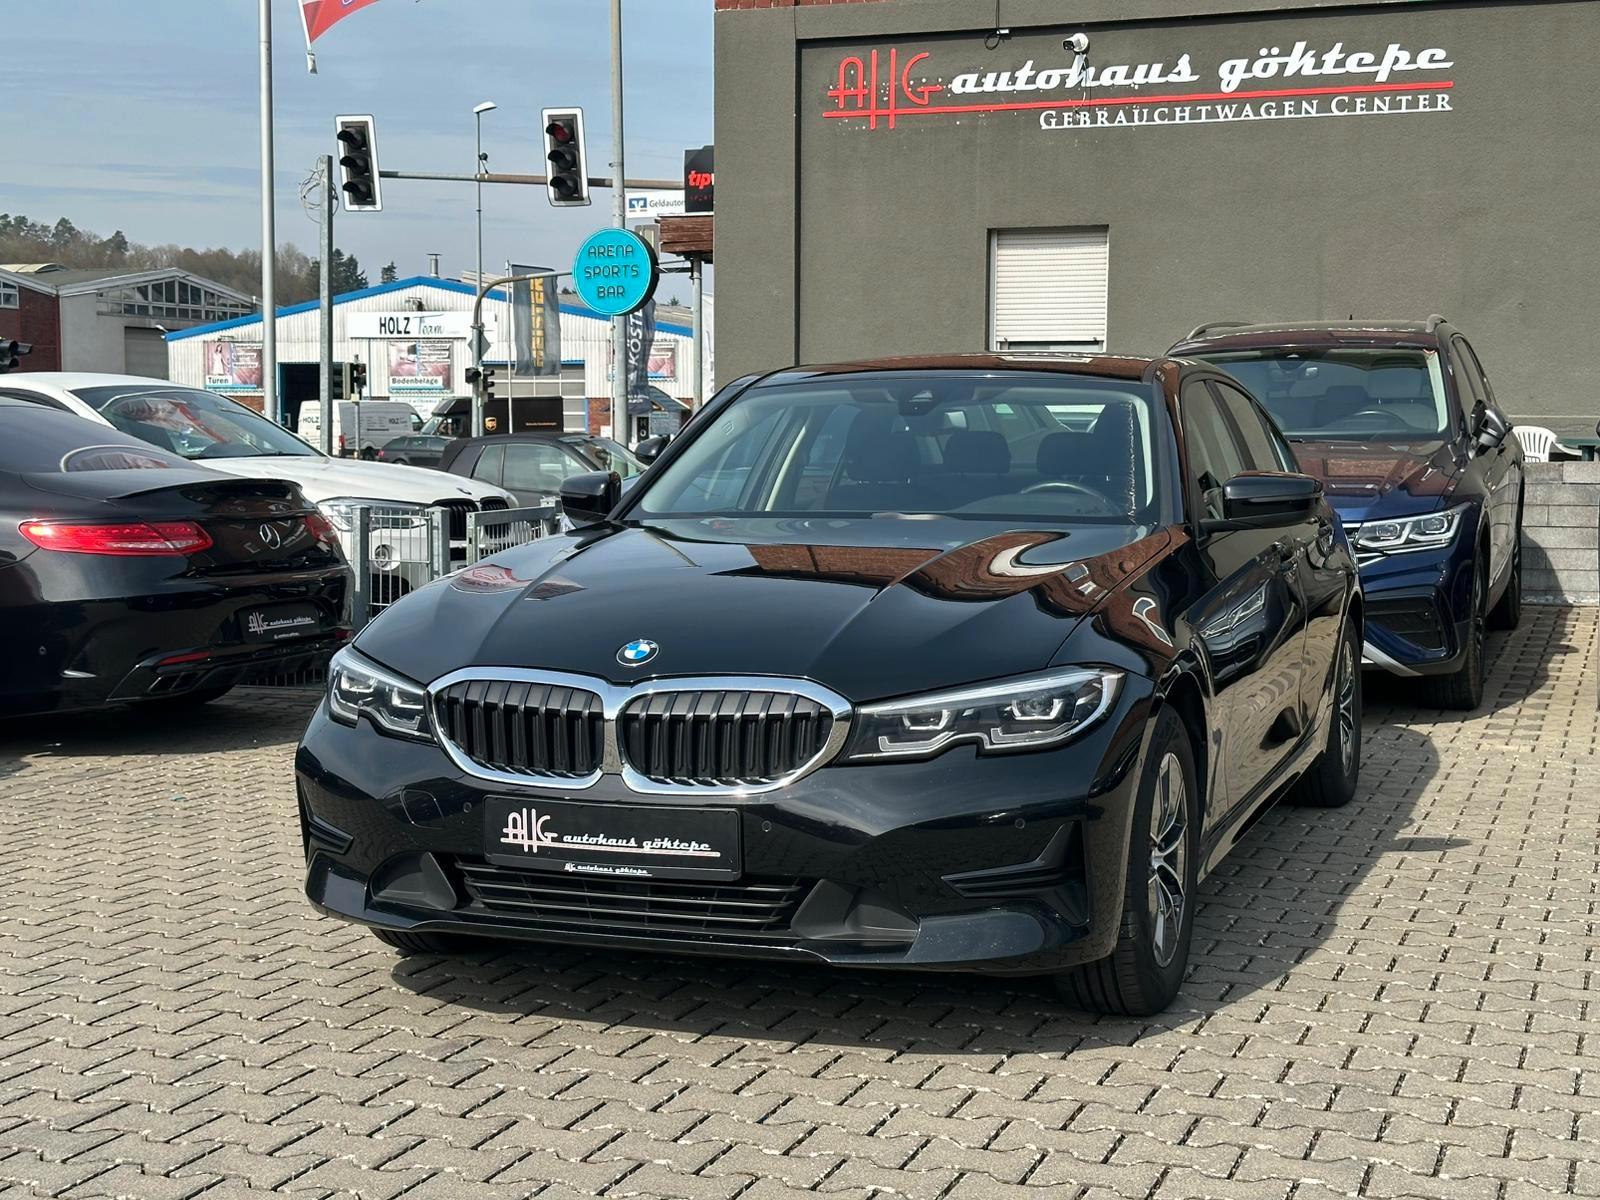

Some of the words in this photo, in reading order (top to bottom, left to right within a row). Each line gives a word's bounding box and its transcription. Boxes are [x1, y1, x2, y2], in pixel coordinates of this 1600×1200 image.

[951, 52, 1200, 95] autohaus
[1217, 40, 1454, 94] göktepe
[1330, 92, 1454, 115] CENTER
[688, 170, 714, 190] tip
[587, 245, 634, 258] ARENA
[584, 264, 640, 279] SPORTS
[597, 285, 625, 298] BAR
[379, 316, 411, 335] HOLZ
[302, 416, 320, 424] HOLZ
[563, 833, 638, 848] autohaus
[642, 838, 711, 852] göktepe
